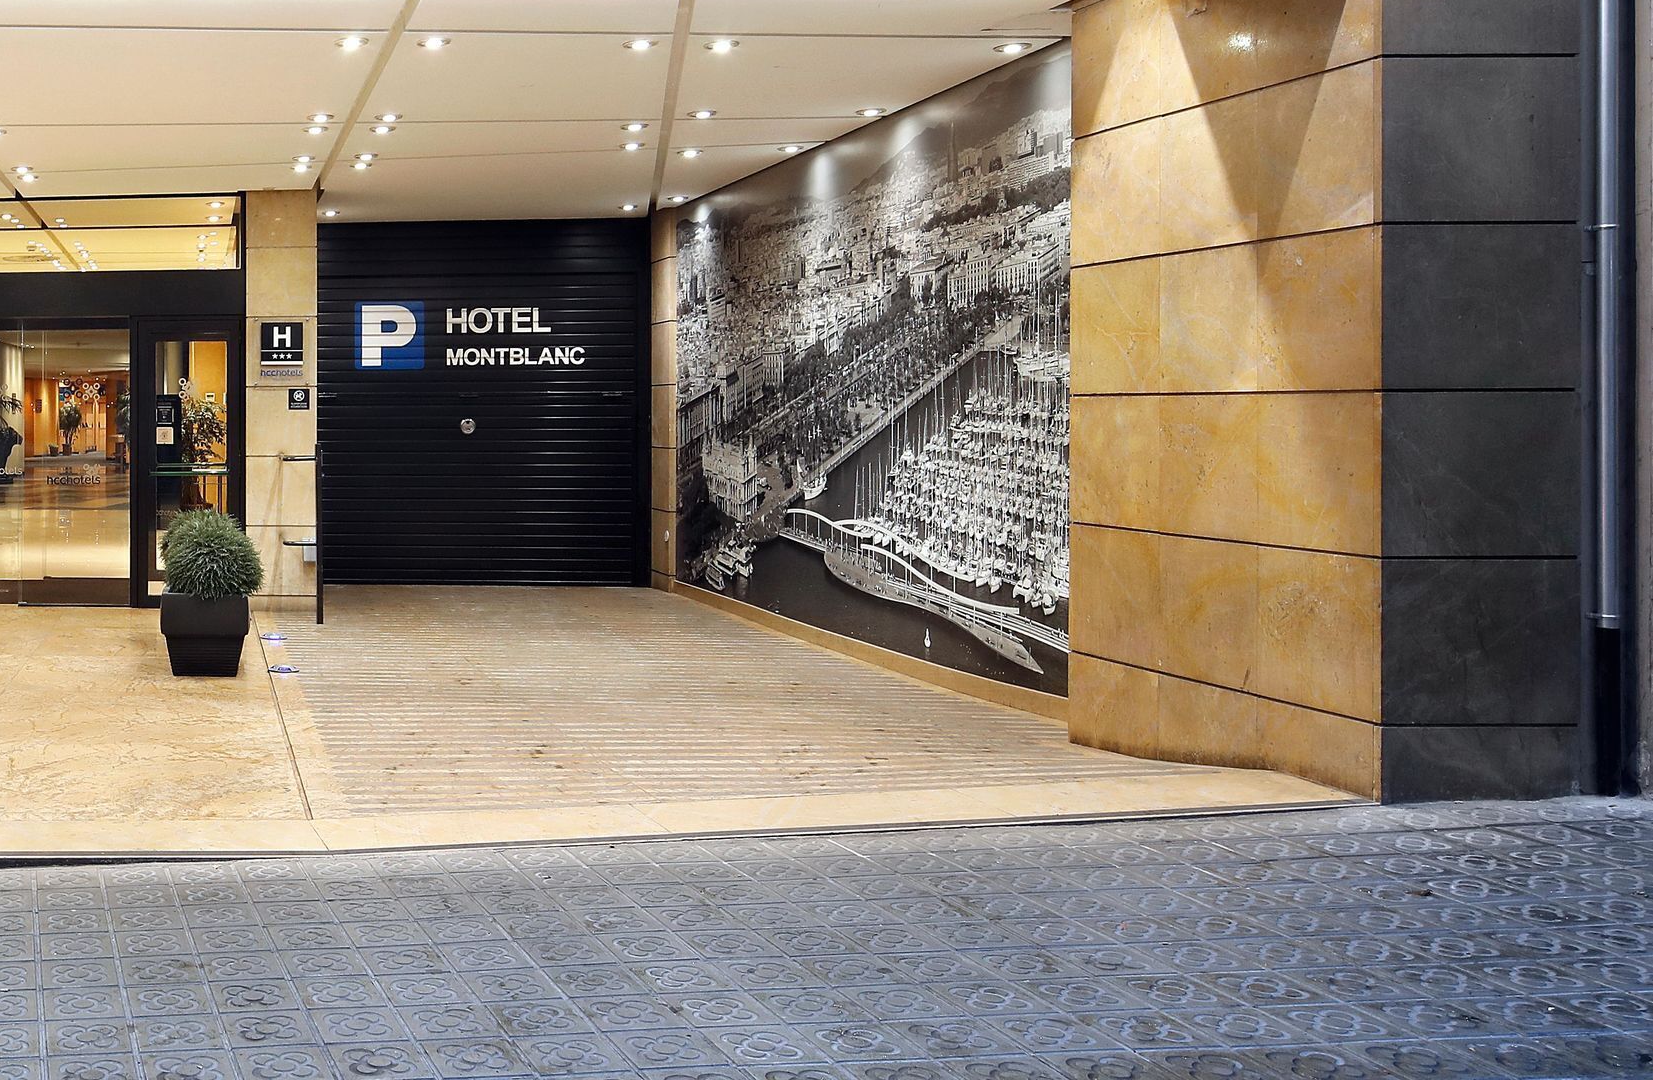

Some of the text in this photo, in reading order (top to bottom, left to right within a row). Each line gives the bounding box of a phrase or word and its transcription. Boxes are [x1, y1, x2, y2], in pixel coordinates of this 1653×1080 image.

[446, 307, 552, 334] HOTEL
[273, 326, 291, 348] H
[361, 304, 417, 367] P
[446, 346, 586, 366] MONTBLANC
[260, 368, 303, 377] hcchotels
[46, 475, 101, 485] hcchotels
